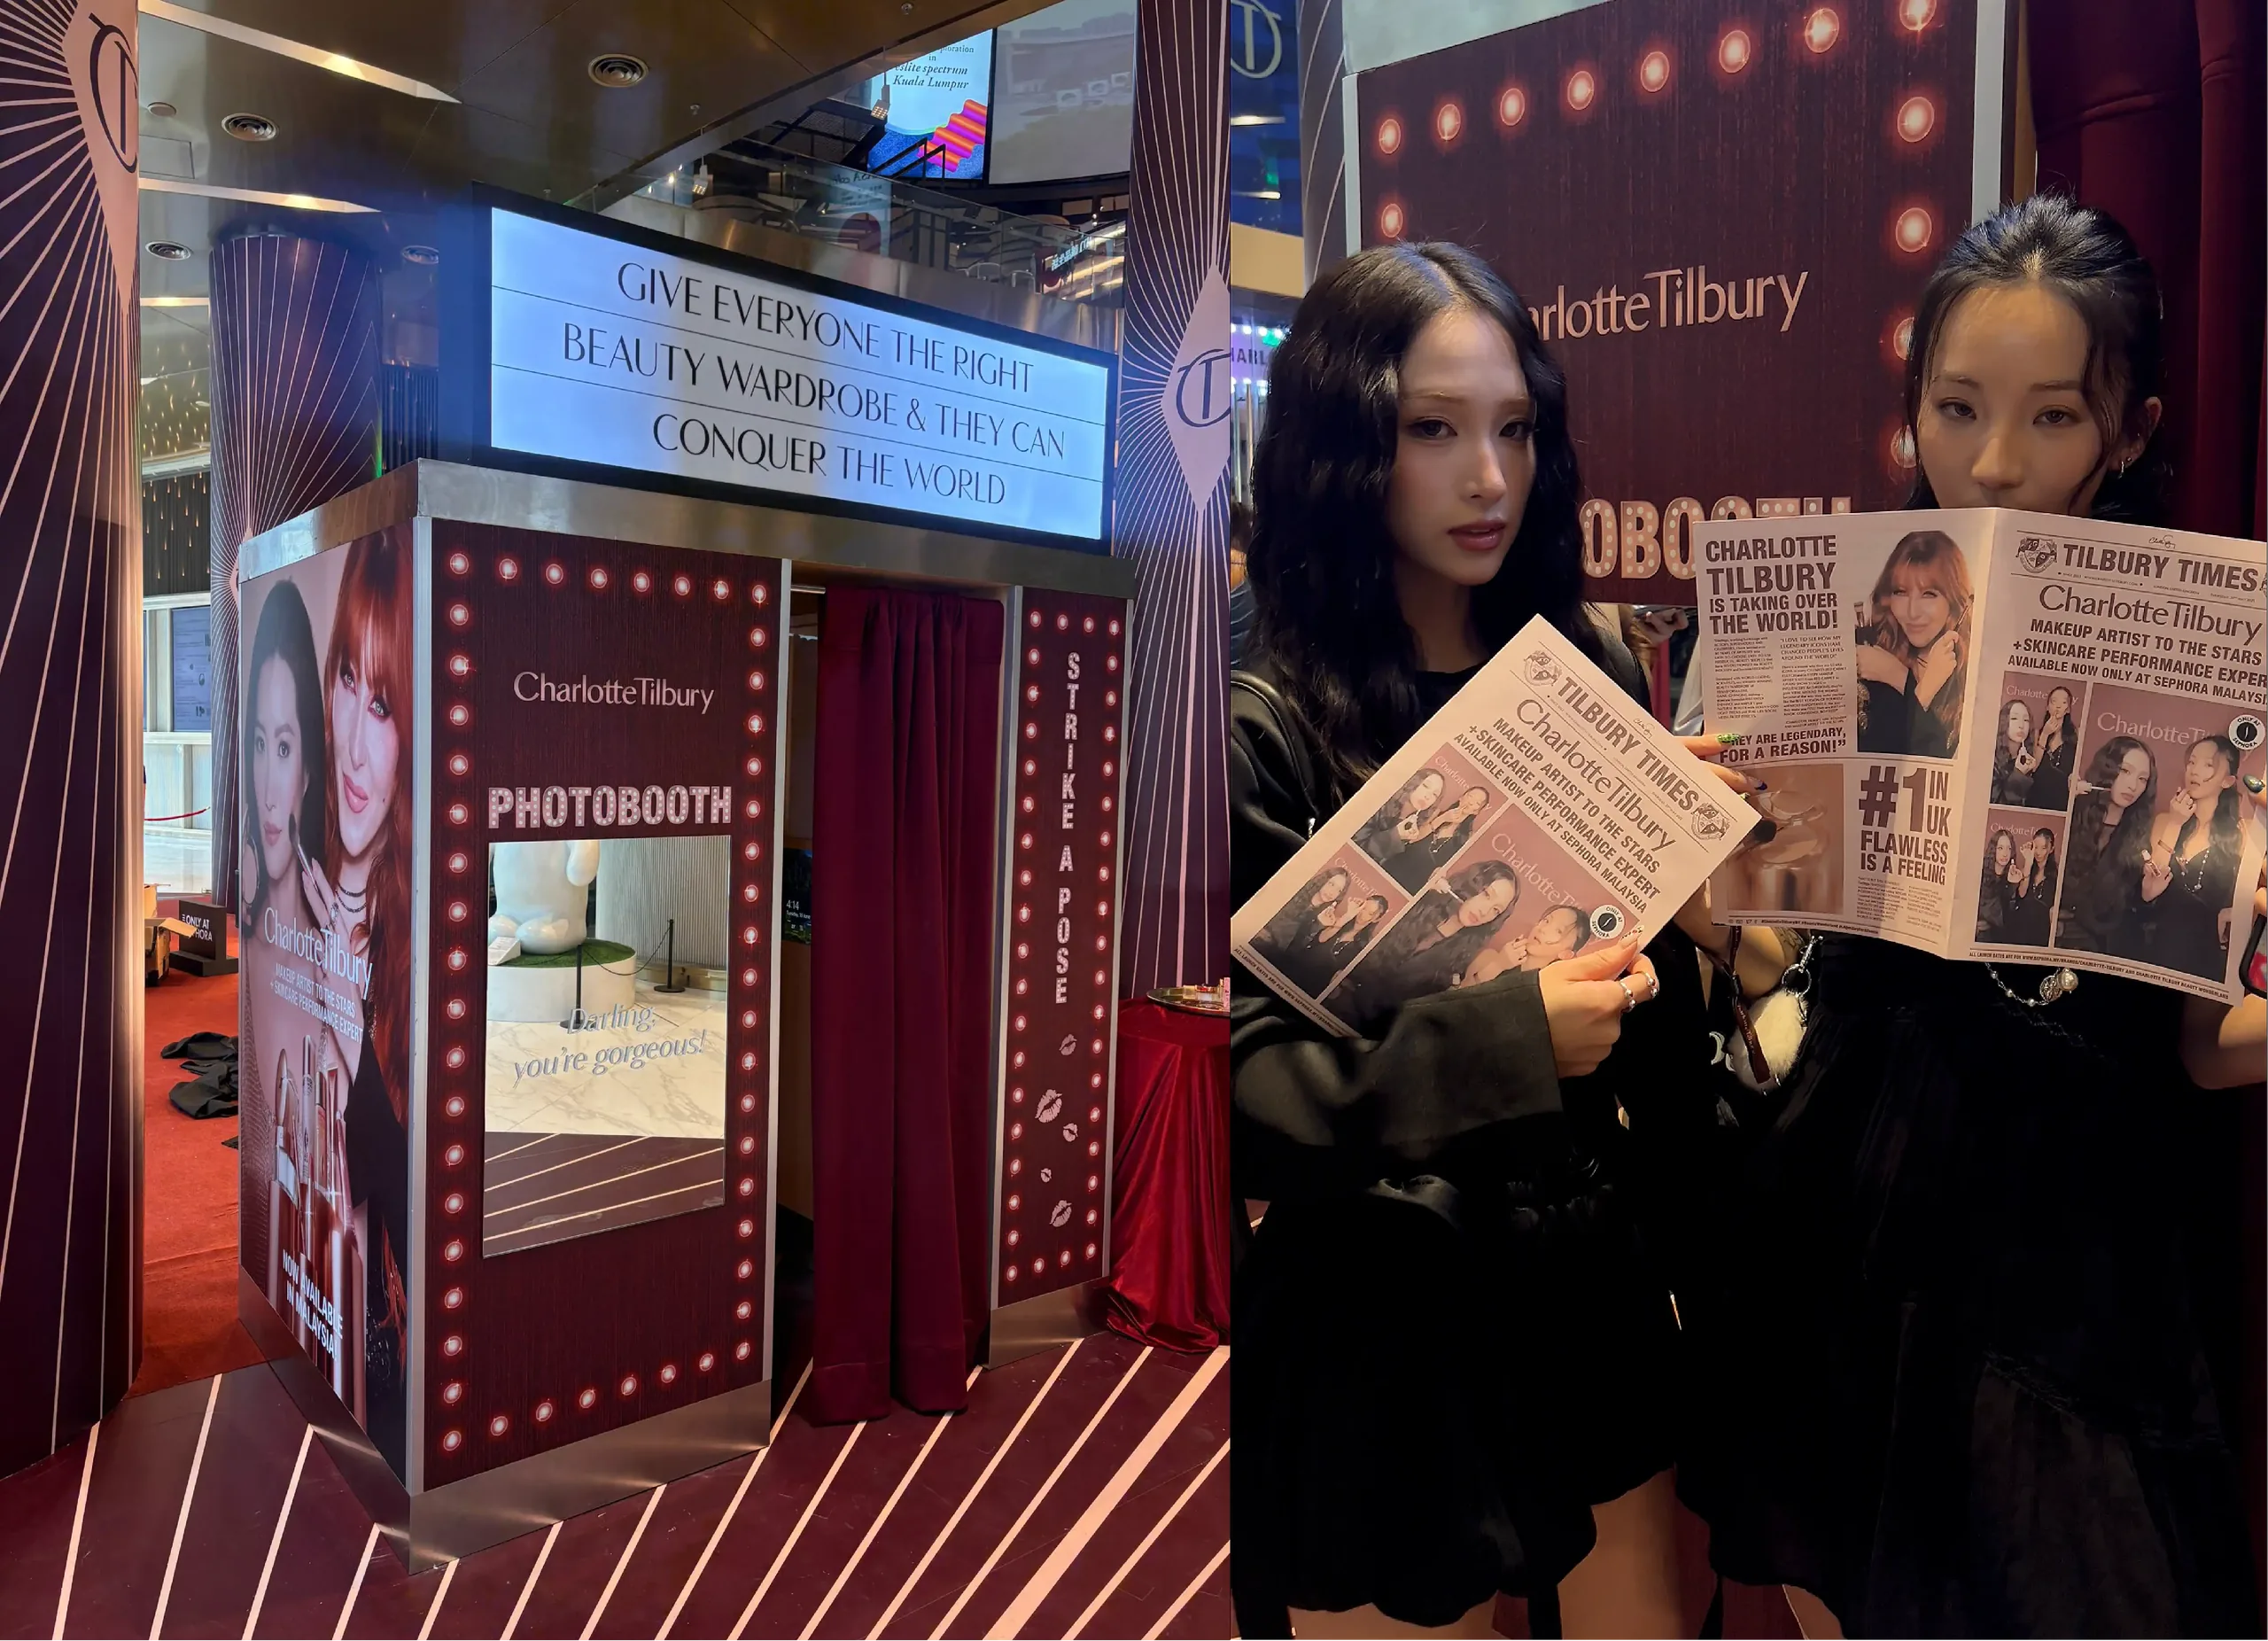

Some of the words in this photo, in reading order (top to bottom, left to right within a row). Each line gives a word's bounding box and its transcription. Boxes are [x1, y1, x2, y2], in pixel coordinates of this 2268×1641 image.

[893, 74, 924, 86] Kuala
[928, 77, 969, 90] Lumpur
[922, 65, 968, 76] spectrum
[1527, 265, 1808, 341] rlotteTilbury
[617, 262, 703, 315] GIVE
[714, 284, 881, 358] EVERYONE
[890, 329, 944, 373] THE
[954, 346, 1034, 393] RIGHT
[564, 323, 705, 385] BEAUTY
[717, 356, 898, 426] WARDROBE
[906, 398, 926, 432] &
[936, 403, 1005, 446] THEY
[1012, 422, 1064, 460] CAN
[653, 414, 827, 476] CONQUER
[837, 446, 893, 487] THE
[905, 458, 1005, 504] WORLD
[1705, 534, 1837, 563] CHARLOTTE
[2063, 543, 2170, 579] TILBURY
[2178, 558, 2258, 592] TIMES
[1706, 562, 1837, 595] TILBURY
[1709, 598, 1725, 613] IS
[1730, 595, 1790, 612] TAKING
[1796, 593, 1837, 610] OVER
[1710, 613, 1749, 635] THE
[1756, 610, 1838, 633] WORLD!
[2030, 618, 2093, 640] MAKEUP
[2096, 627, 2151, 649] ARTIST
[2155, 635, 2174, 651] TO
[2179, 639, 2208, 657] THE
[2211, 645, 2263, 666] STARS
[2008, 655, 2069, 673] AVAILABLE
[2070, 663, 2099, 677] NOW
[2101, 667, 2133, 682] ONLY
[2134, 672, 2151, 685] AT
[2154, 676, 2215, 695] SEPHORA
[2212, 685, 2266, 705] MALAYSI
[2101, 649, 2214, 680] PERFORMANCE
[2218, 667, 2266, 688] EXPER
[1060, 652, 1081, 829] STRIKE
[1557, 676, 1642, 756] TILBURY
[1636, 749, 1699, 812] TIMES
[1720, 748, 1749, 763] FOR
[1754, 747, 1765, 759] A
[1732, 735, 1752, 746] HEY
[1756, 734, 1777, 744] ARE
[1781, 727, 1846, 742] LEGENDARY,
[2233, 737, 2257, 748] SEPHORA
[488, 785, 732, 828] PHOTOBOOTH
[1493, 717, 1544, 764] MAKEUP
[1540, 762, 1585, 803] ARTIST
[1581, 797, 1601, 818] TO
[1597, 813, 1624, 840] THE
[1620, 836, 1661, 874] STARS
[1859, 766, 1927, 832] #1
[1930, 770, 1949, 801] IN
[1454, 733, 1503, 780] AVAILABLE
[1501, 776, 1526, 799] NOW
[1524, 796, 1550, 820] ONLY
[1547, 818, 1564, 833] AT
[1560, 829, 1602, 872] SEPHORA
[1600, 869, 1648, 914] MALAYSIA
[1531, 781, 1617, 861] PERFORMANCE
[1613, 854, 1661, 899] EXPERT
[1926, 805, 1952, 837] UK
[1059, 845, 1074, 871] A
[1860, 830, 1949, 865] FLAWLESS
[1860, 852, 1876, 872] IS
[1883, 855, 1892, 875] A
[1898, 858, 1946, 885] FEELING
[186, 914, 201, 927] ONLY
[202, 918, 210, 929] AT
[1591, 921, 1610, 937] SEPHORA
[1605, 906, 1619, 916] ONLY
[195, 929, 213, 942] HORA
[1055, 887, 1071, 1004] POSE
[276, 963, 295, 984] MAKEUP
[296, 973, 315, 995] ARTIST
[315, 982, 323, 999] TO
[323, 987, 335, 1007] THE
[336, 993, 355, 1018] STARS
[2136, 971, 2161, 981] CHARLOTTE
[2180, 982, 2197, 991] BEAUTY
[2199, 987, 2228, 999] WONDERLAND
[274, 980, 298, 1006] SKINCARE
[299, 993, 338, 1029] PERFORMANCE
[339, 1015, 363, 1045] EXPERT
[592, 1029, 707, 1075] gorgeous!
[283, 1248, 299, 1284] NOW
[300, 1272, 343, 1340] AVAILABLE
[286, 1279, 294, 1307] IN
[296, 1291, 338, 1361] MALAYSIA!
